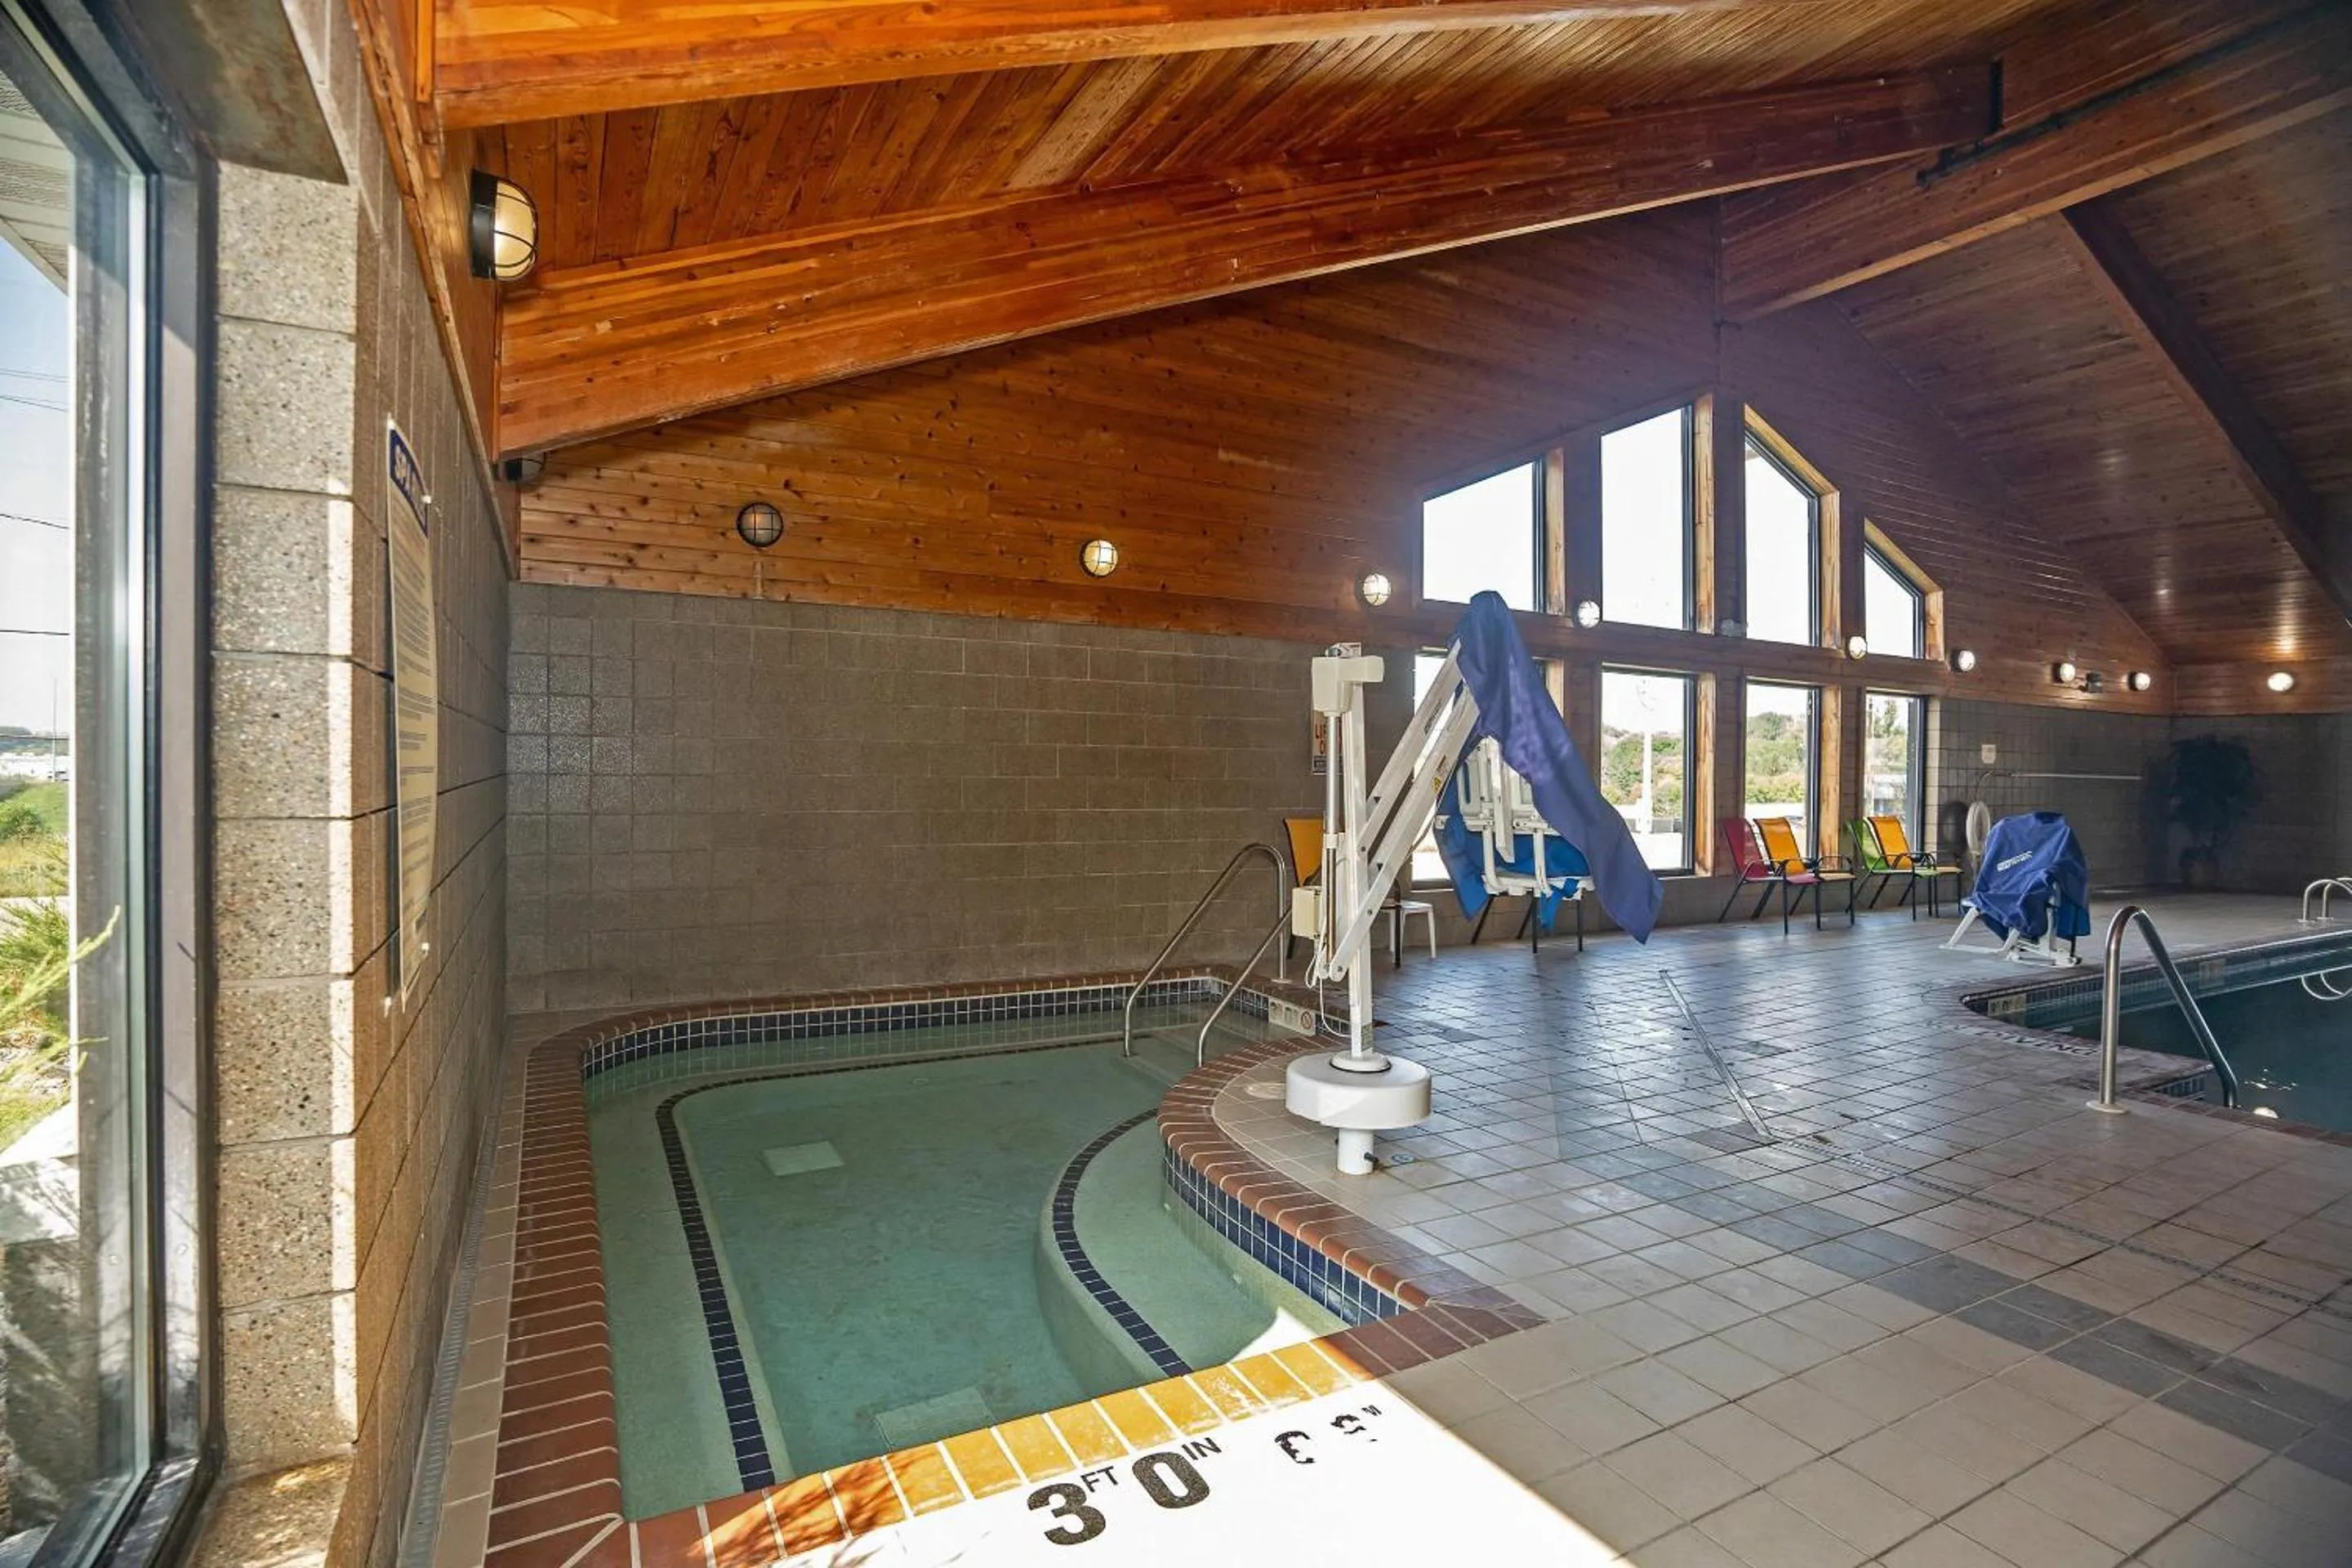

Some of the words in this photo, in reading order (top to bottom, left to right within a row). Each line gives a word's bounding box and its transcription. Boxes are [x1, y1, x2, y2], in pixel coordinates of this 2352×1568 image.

[1027, 1482, 1107, 1546] 3
[1080, 1465, 1119, 1493] FT
[1181, 1437, 1223, 1461] IN
